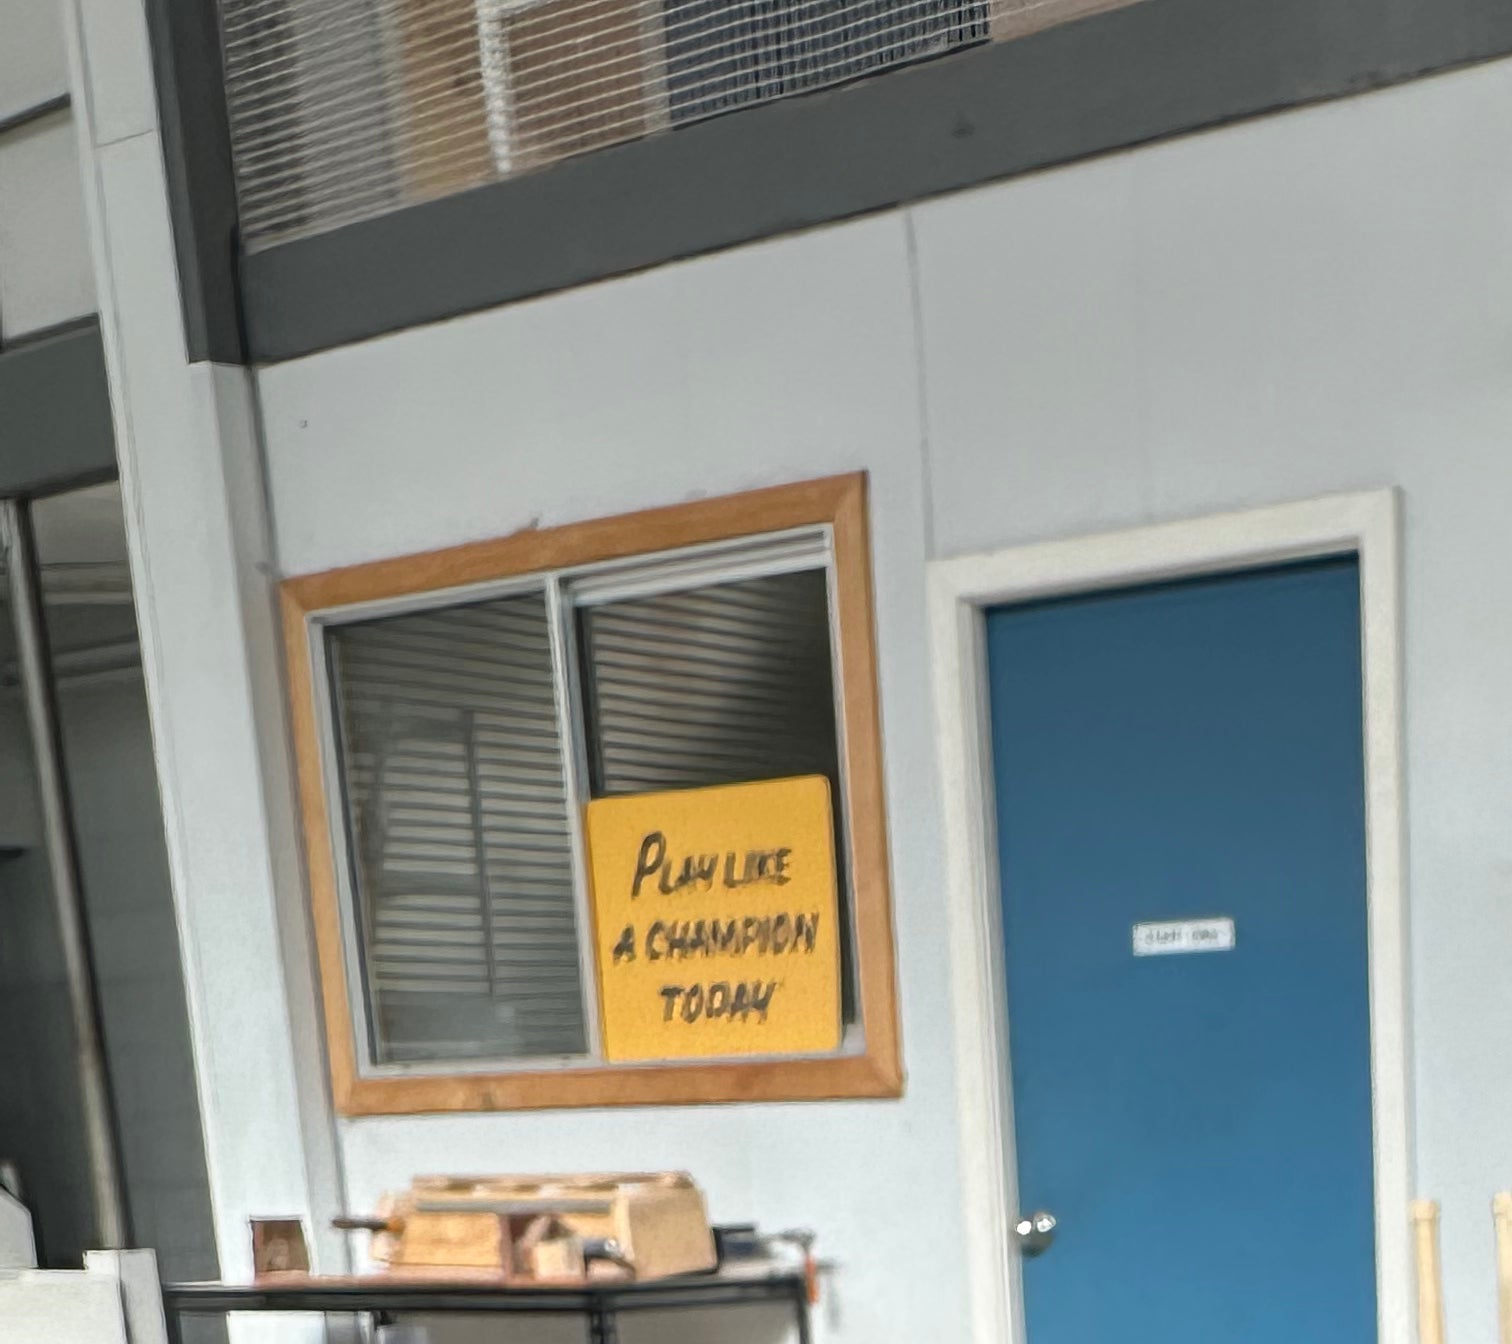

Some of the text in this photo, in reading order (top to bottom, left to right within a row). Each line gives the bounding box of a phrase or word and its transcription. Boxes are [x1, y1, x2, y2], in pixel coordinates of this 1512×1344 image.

[722, 846, 793, 889] LIKE
[612, 910, 820, 966] A CHAMPION
[660, 978, 778, 1025] TODAY
